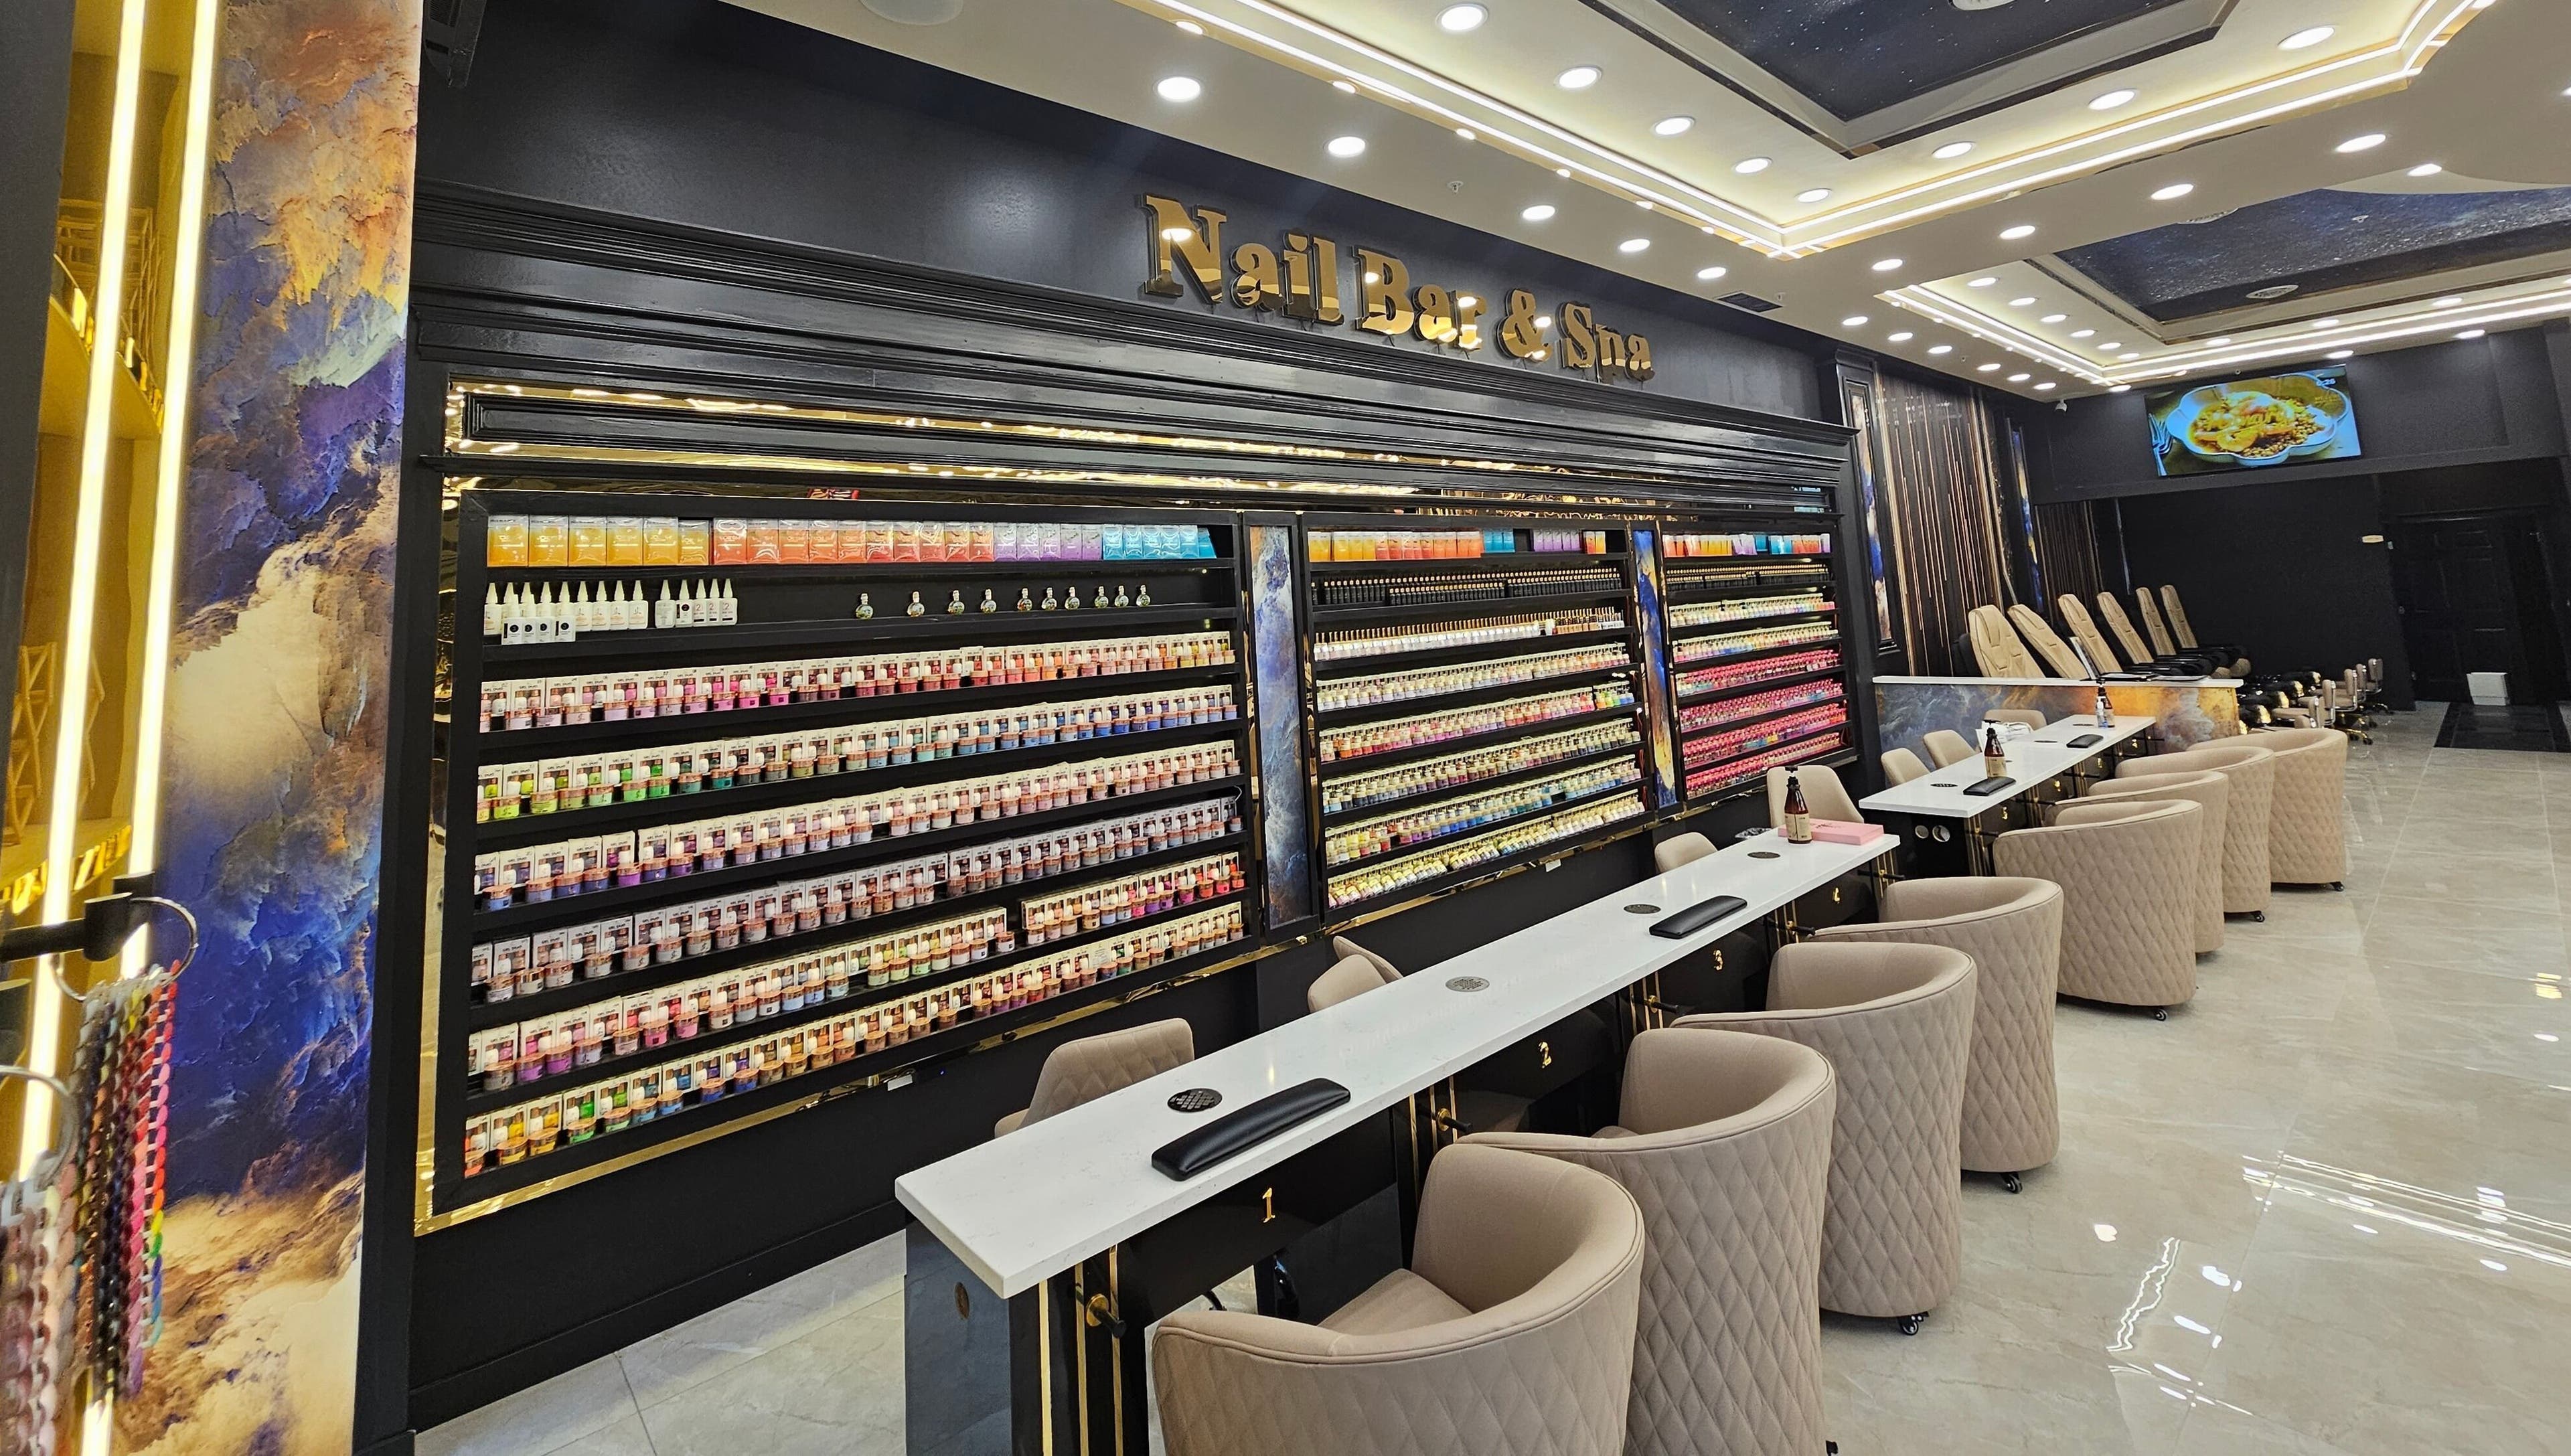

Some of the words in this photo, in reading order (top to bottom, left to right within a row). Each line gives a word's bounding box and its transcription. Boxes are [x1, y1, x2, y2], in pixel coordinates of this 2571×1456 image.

[1142, 194, 1343, 325] Nail
[1352, 245, 1486, 351] Bar
[1497, 288, 1552, 362] &
[1555, 301, 1655, 384] Spa
[1713, 949, 1723, 971] 3
[1538, 1041, 1552, 1068] 2
[1262, 1187, 1275, 1223] 1
